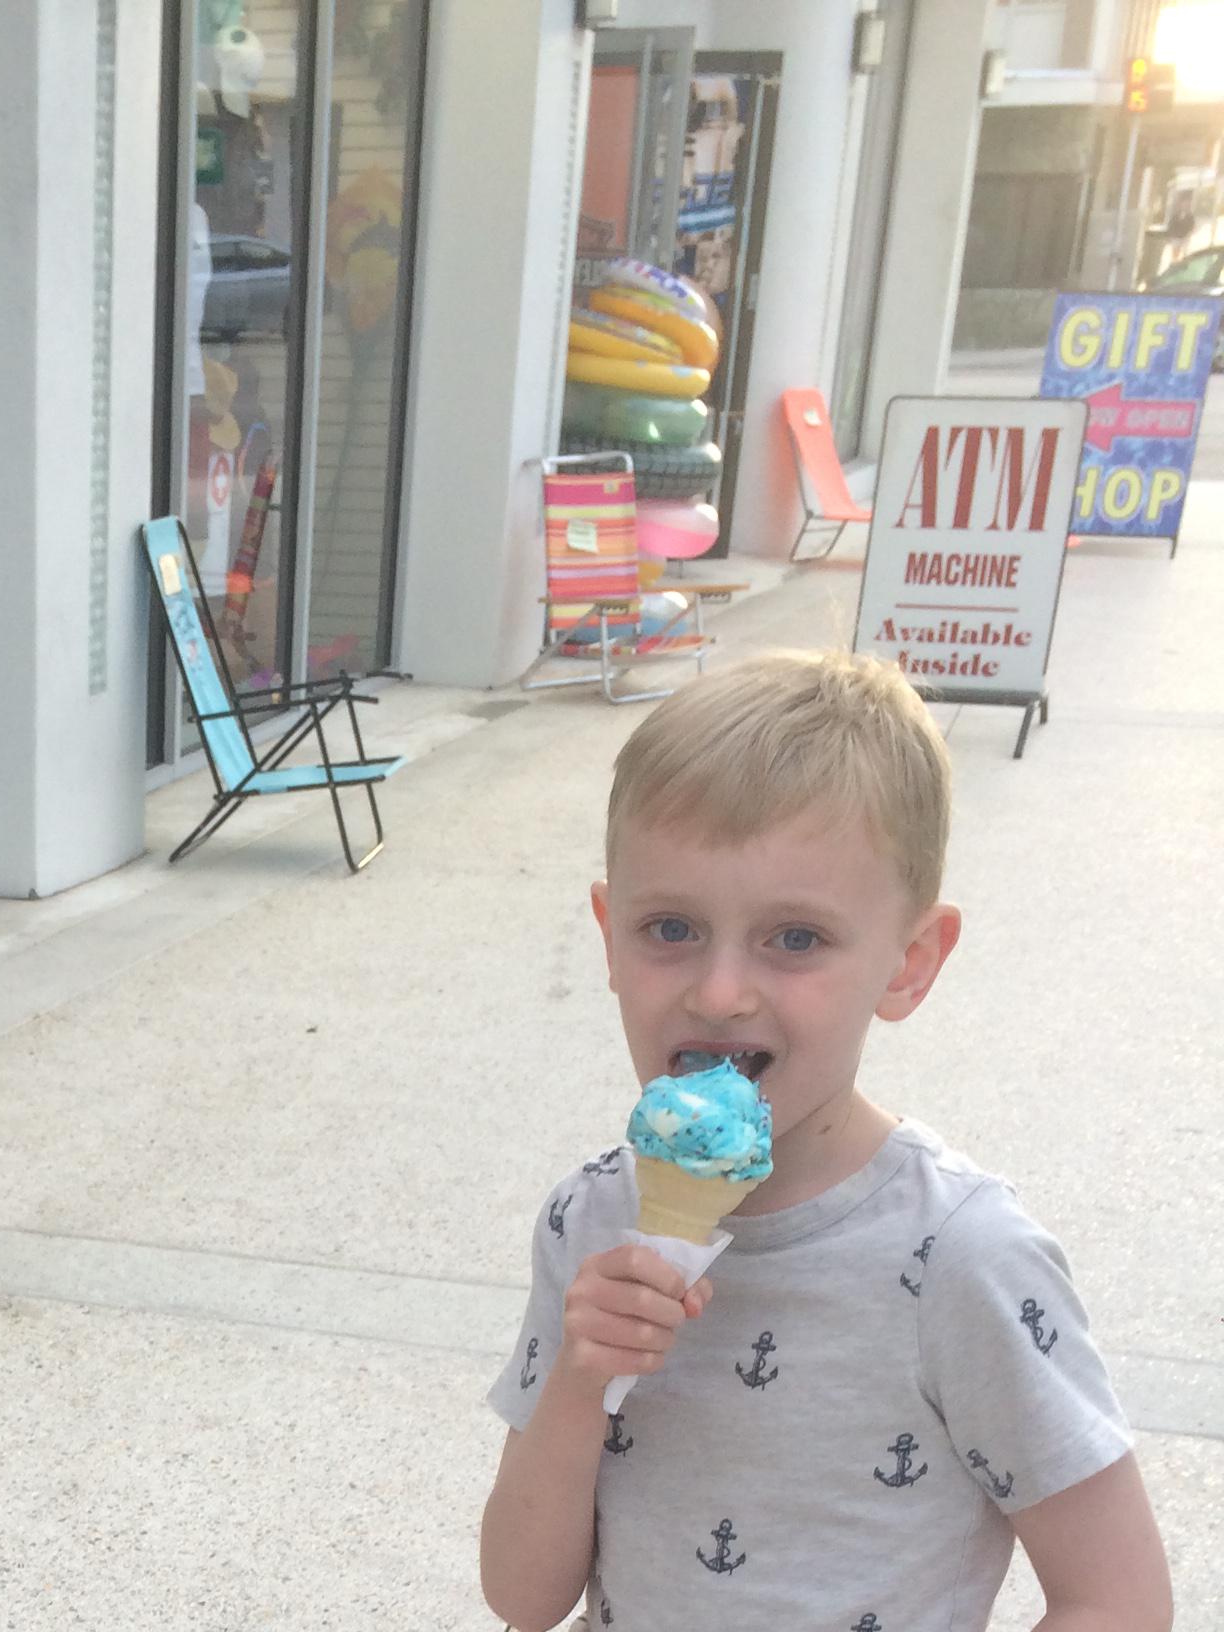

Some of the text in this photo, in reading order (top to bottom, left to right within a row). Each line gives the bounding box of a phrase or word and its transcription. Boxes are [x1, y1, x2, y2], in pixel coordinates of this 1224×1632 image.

[1058, 310, 1210, 372] GIFT
[893, 424, 1064, 532] ATM
[1077, 467, 1182, 521] HOP
[904, 552, 1022, 589] MACHINE
[874, 616, 1033, 647] Available
[897, 650, 1000, 678] Inside
